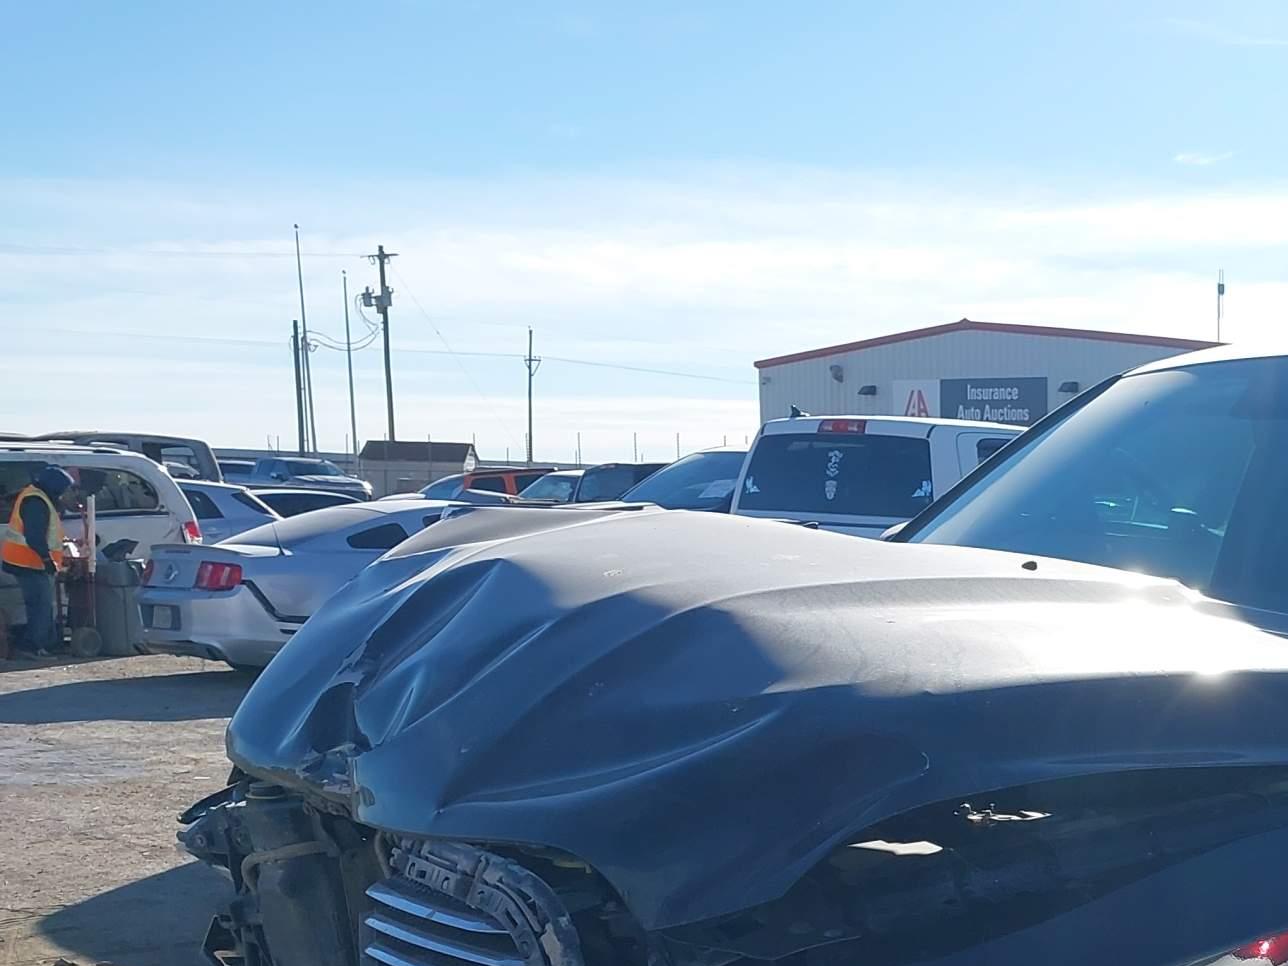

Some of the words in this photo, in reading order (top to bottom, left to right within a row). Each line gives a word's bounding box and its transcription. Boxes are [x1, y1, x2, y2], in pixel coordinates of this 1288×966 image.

[967, 384, 1019, 400] Insurance
[957, 404, 982, 420] Auto
[983, 404, 1030, 421] Auctions
